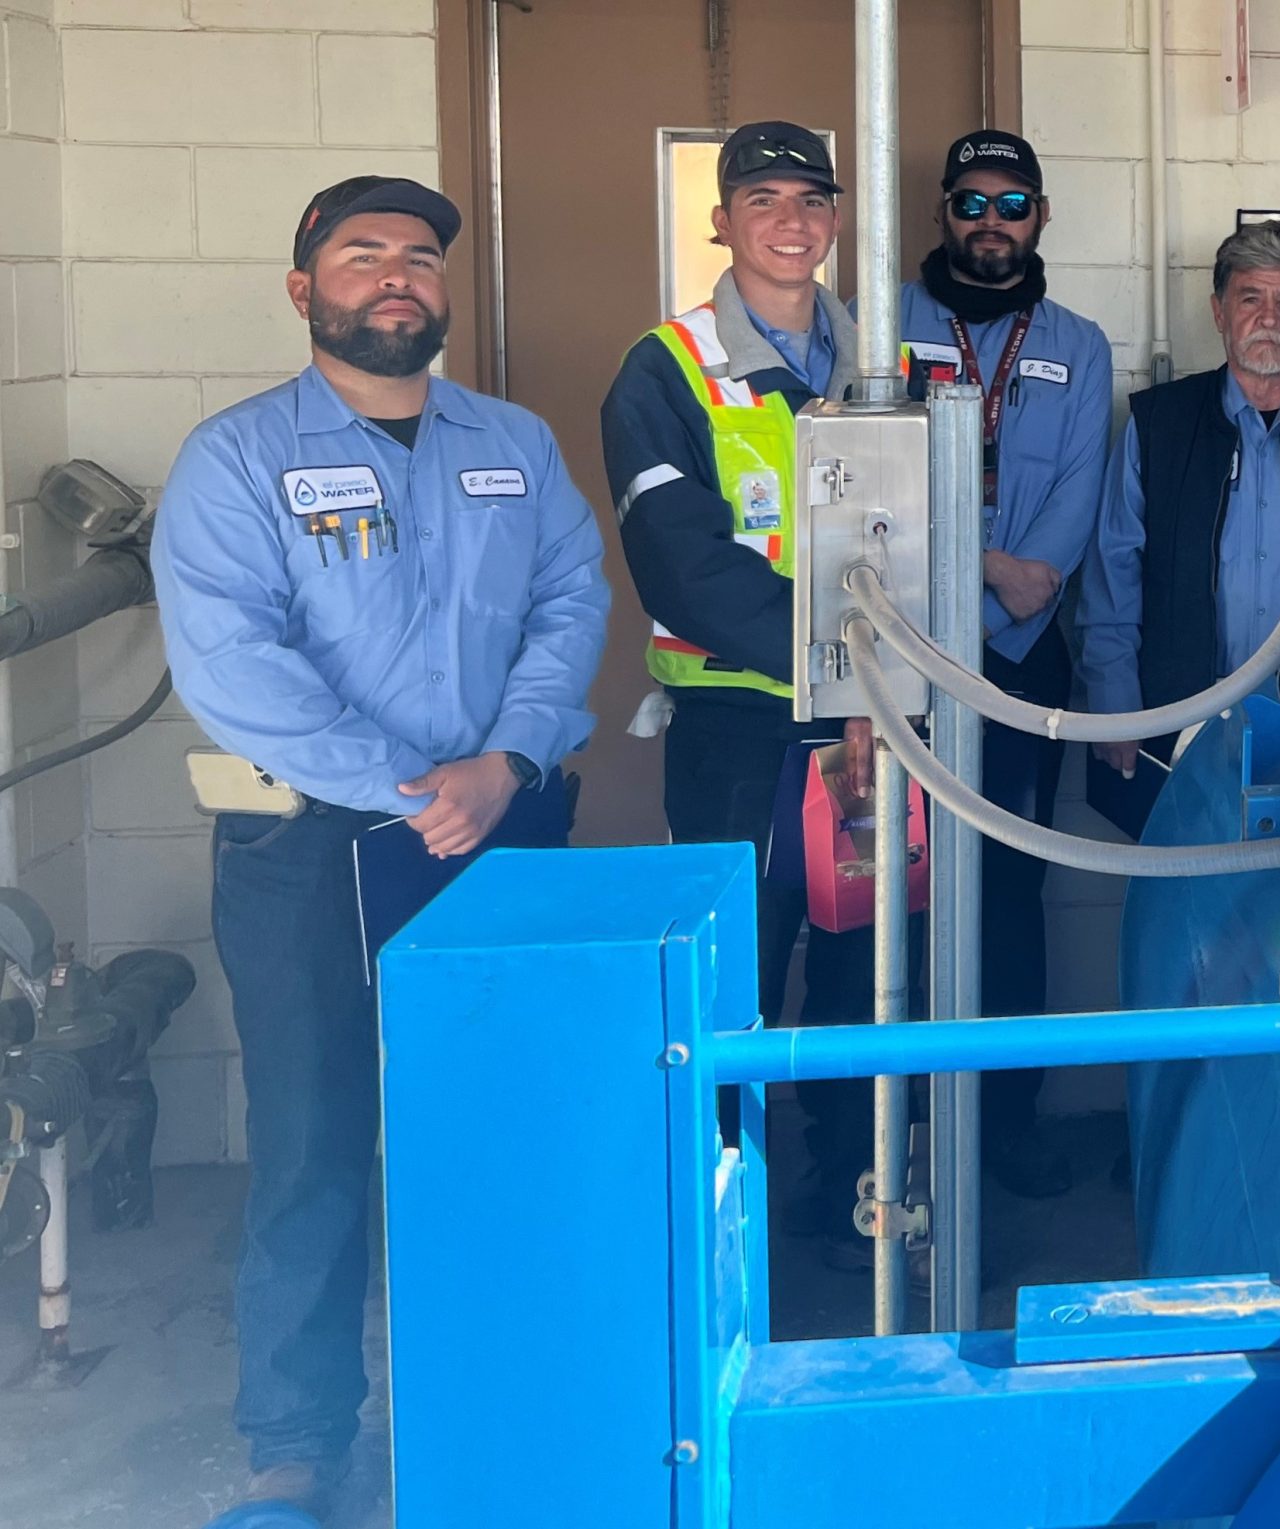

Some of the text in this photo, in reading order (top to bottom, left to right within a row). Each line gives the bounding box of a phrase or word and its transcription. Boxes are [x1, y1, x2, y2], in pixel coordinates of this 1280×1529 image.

[977, 149, 1019, 160] WATER
[1004, 327, 1026, 369] FALCONS
[320, 486, 375, 498] WATER
